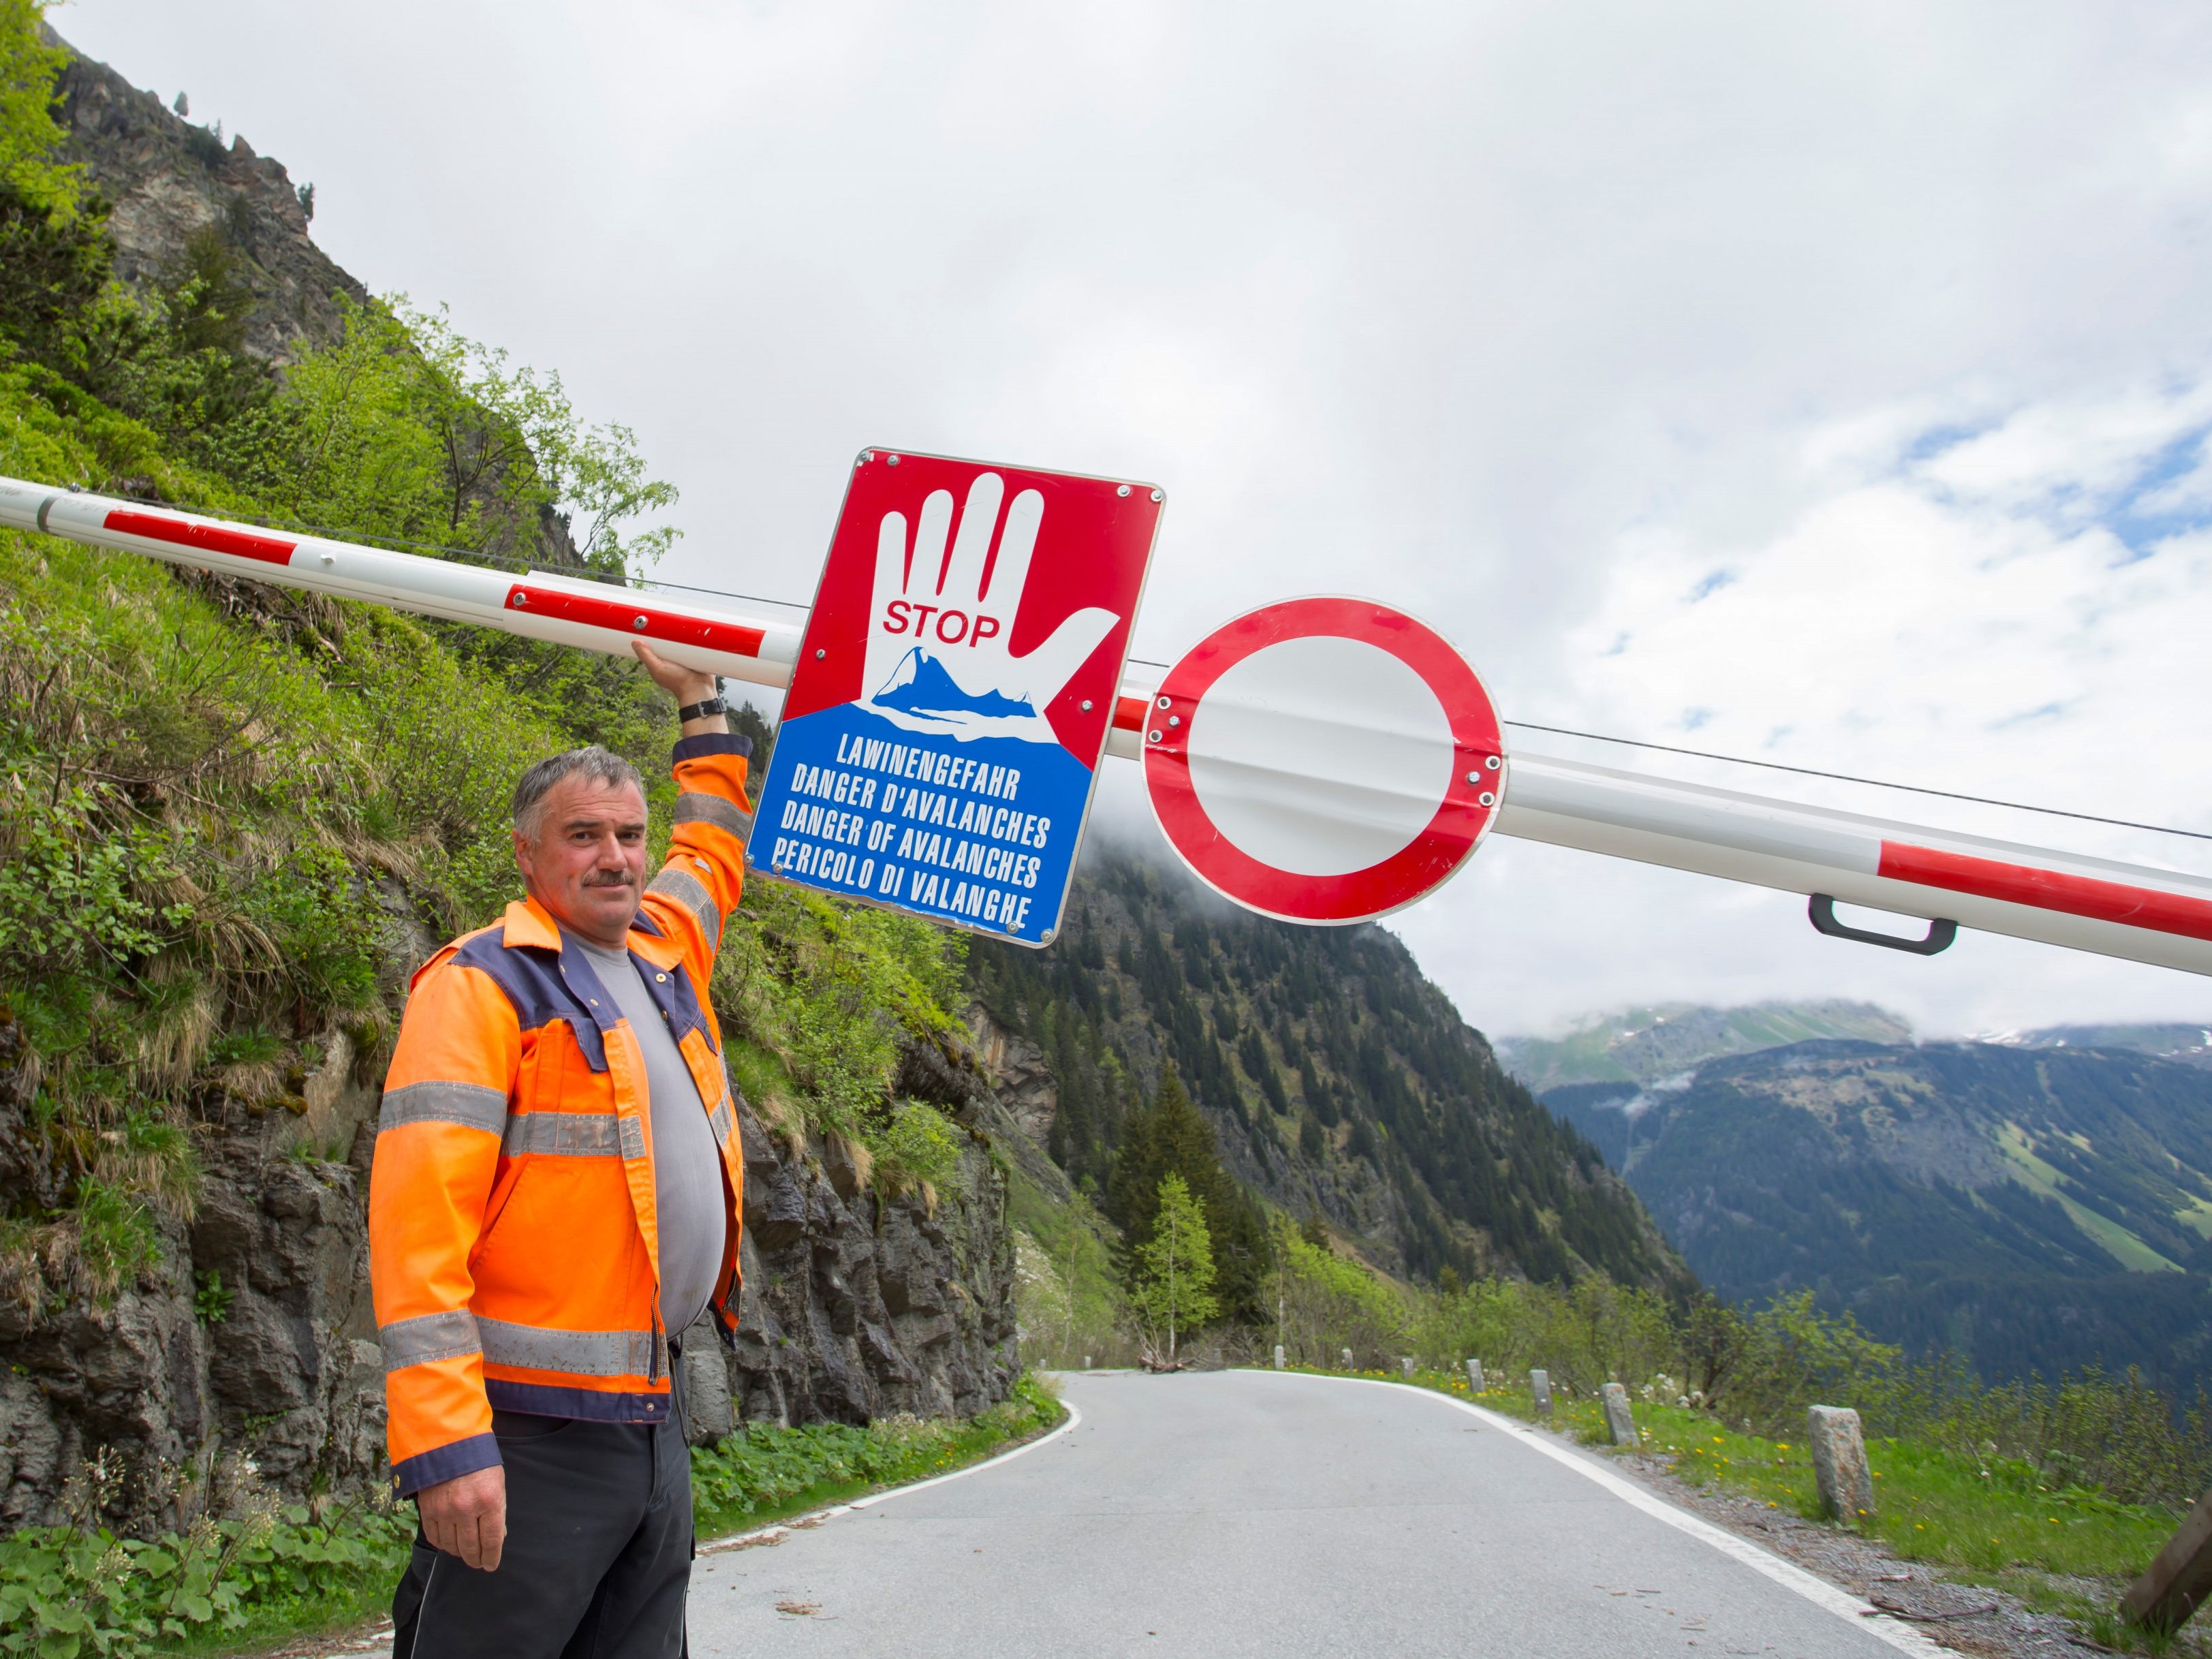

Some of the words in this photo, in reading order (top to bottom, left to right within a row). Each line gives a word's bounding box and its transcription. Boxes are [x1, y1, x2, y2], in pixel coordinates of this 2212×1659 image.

[882, 600, 1000, 648] STOP
[790, 762, 877, 809] DANGER
[880, 783, 1051, 849] D'AVALANCHES
[836, 733, 1021, 801] LAWINENGEFAHR
[771, 837, 875, 889] PERICOLO
[879, 863, 905, 897] DI
[910, 870, 1032, 929] VALANGHE
[780, 800, 864, 846] DANGER
[867, 820, 897, 852] OF
[897, 828, 1041, 888] AVALANCHES
